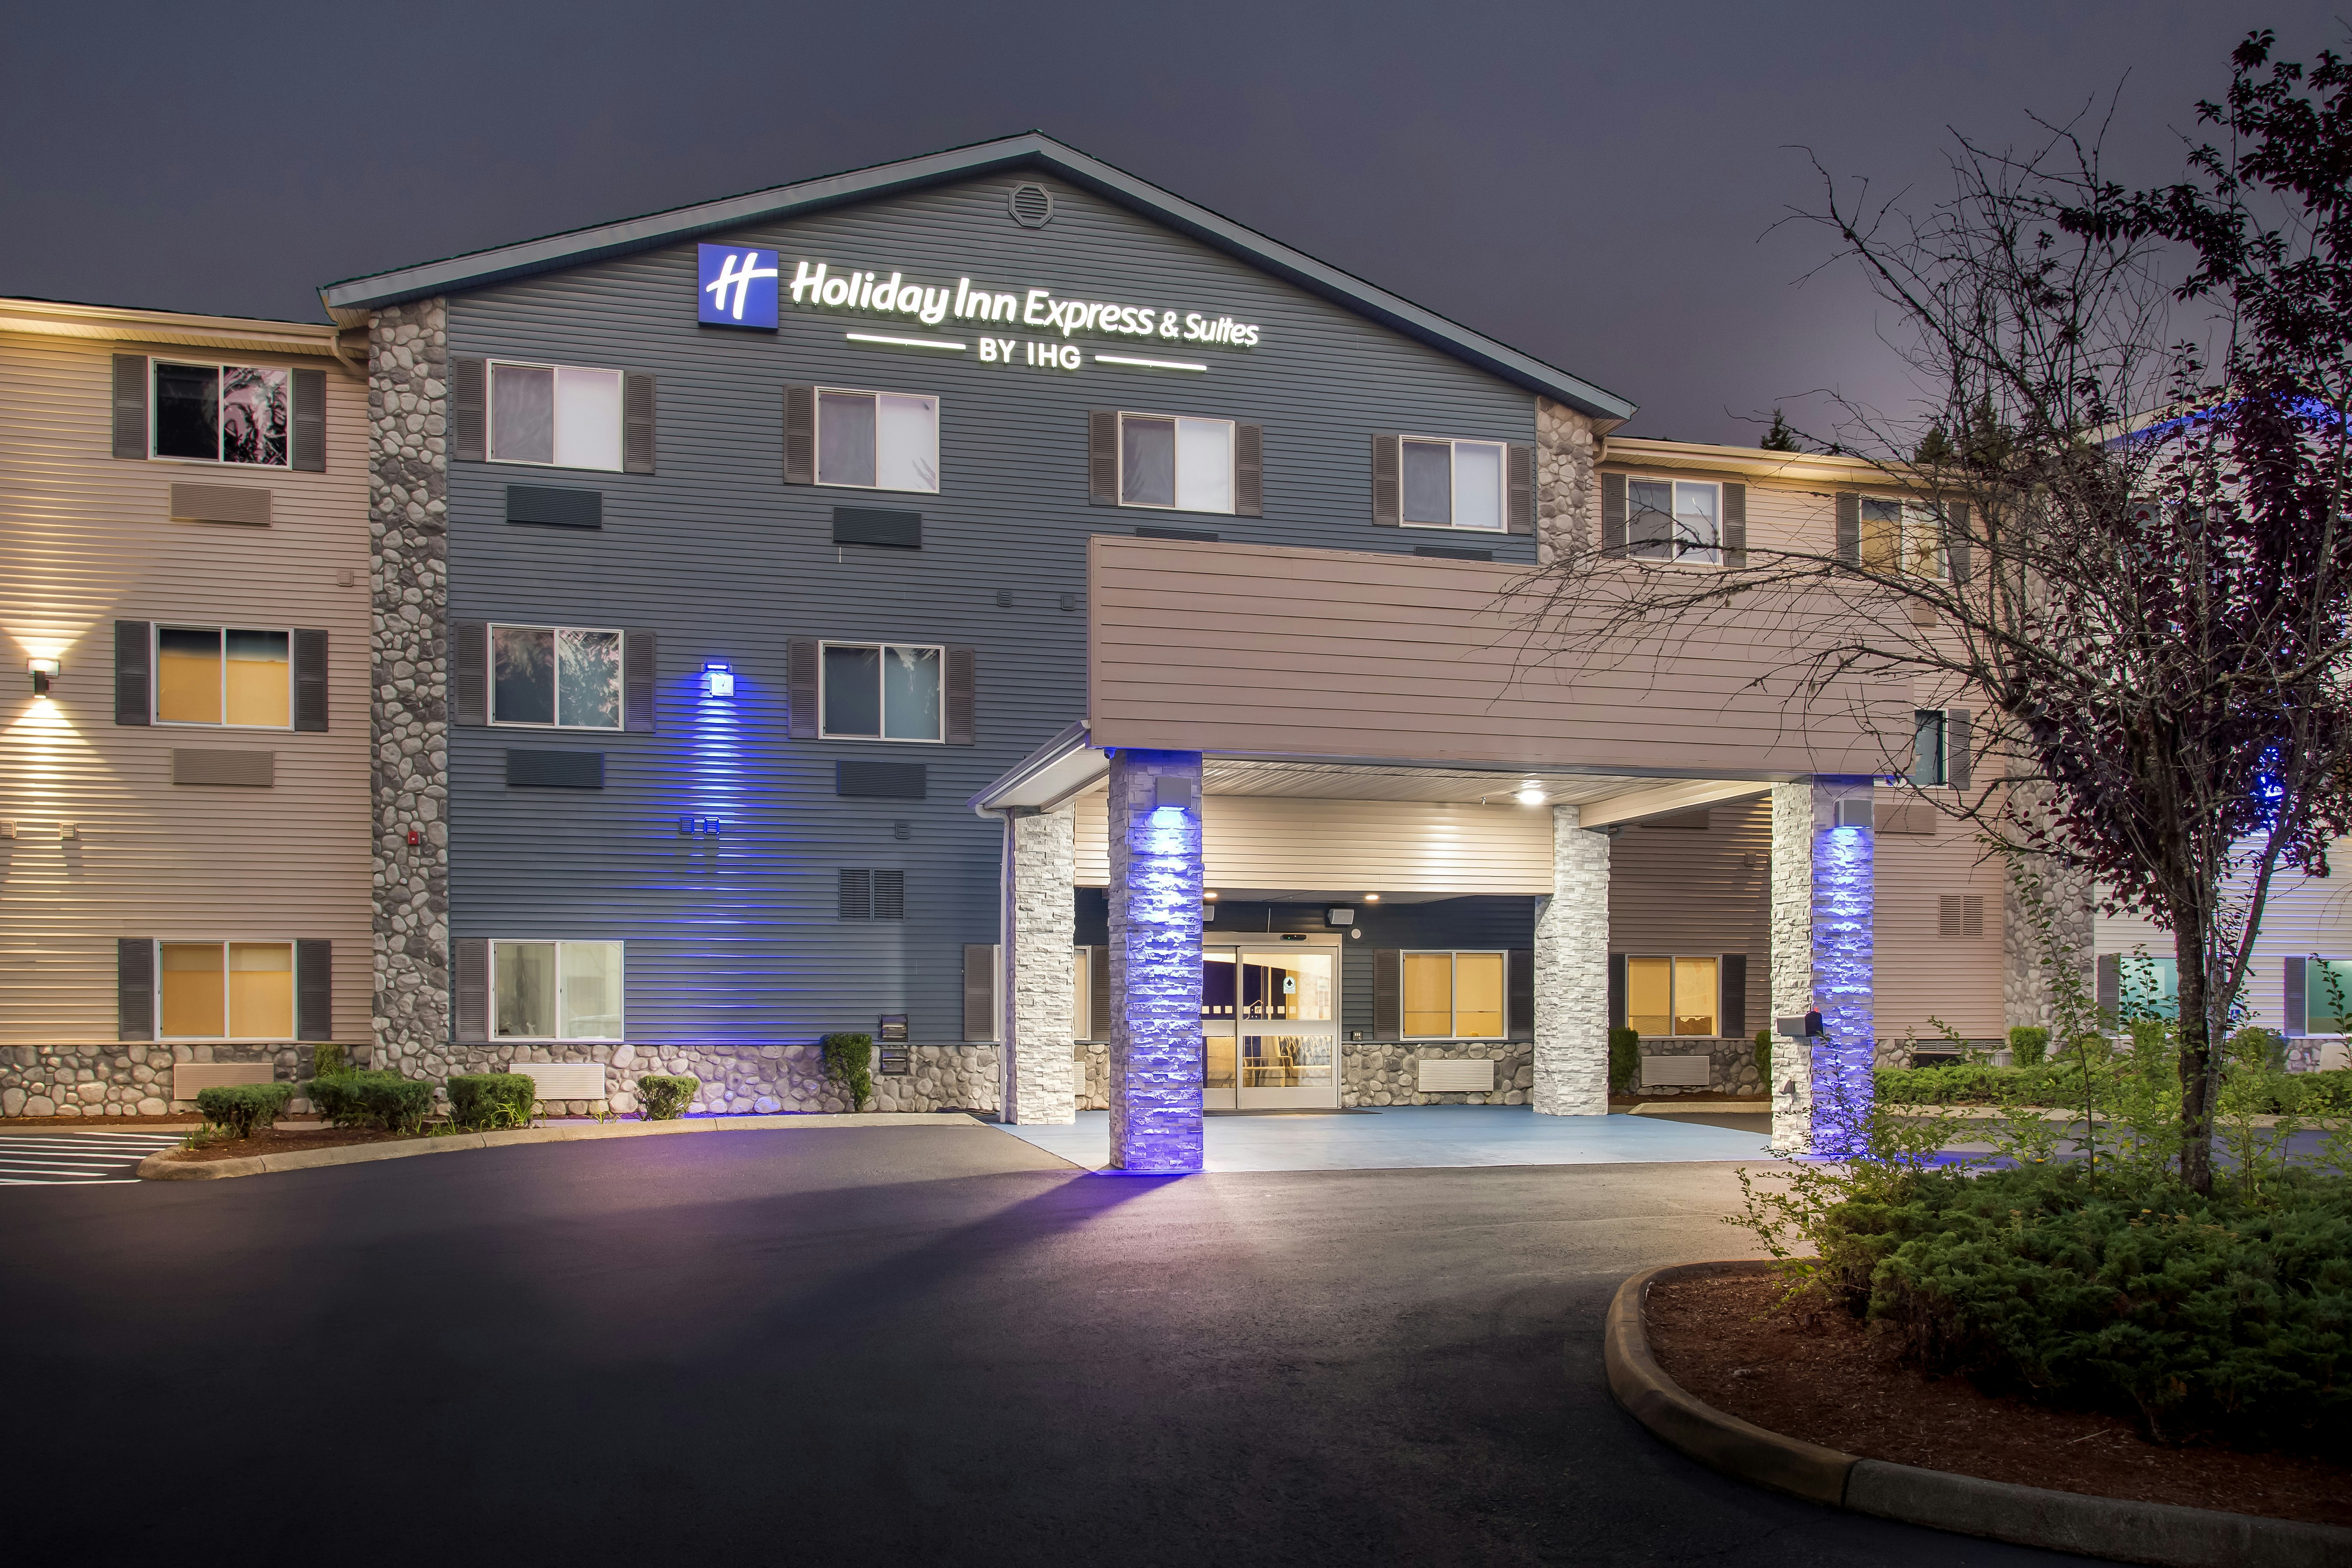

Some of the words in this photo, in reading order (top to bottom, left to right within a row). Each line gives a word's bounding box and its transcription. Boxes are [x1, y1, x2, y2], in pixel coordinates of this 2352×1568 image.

[790, 261, 949, 324] Holiday
[954, 278, 1017, 322] Inn
[1024, 290, 1155, 337] Express
[1159, 311, 1179, 337] &
[1183, 313, 1259, 347] Suites
[980, 337, 1016, 362] BY
[1028, 342, 1081, 369] IHG
